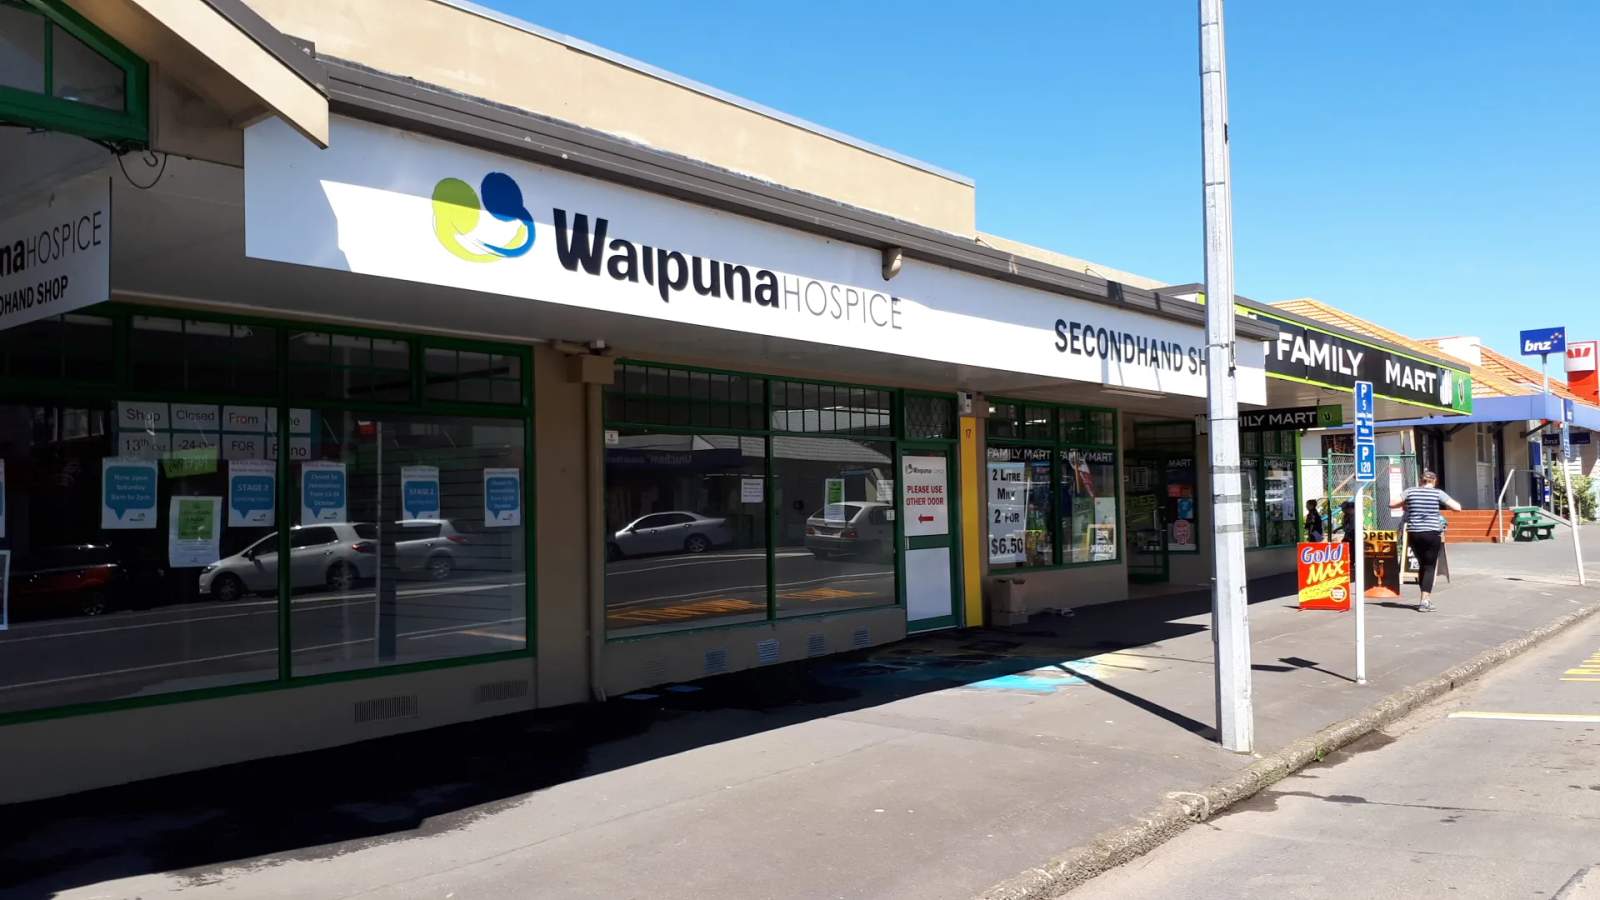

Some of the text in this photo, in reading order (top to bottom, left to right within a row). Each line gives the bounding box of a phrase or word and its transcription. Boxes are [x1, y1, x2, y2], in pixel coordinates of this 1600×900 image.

[37, 275, 68, 305] SHOP
[1054, 319, 1208, 376] SECONDHAND SH
[1524, 340, 1552, 352] bnz
[1276, 331, 1364, 377] FAMILY
[1385, 359, 1437, 394] MART
[1361, 384, 1368, 398] P
[1362, 400, 1367, 411] 5
[229, 412, 258, 425] From
[1239, 411, 1317, 428] ILY MART
[987, 448, 1052, 460] FAMILY MART
[1089, 452, 1113, 462] MART
[1362, 447, 1369, 461] P
[992, 468, 998, 481] 2
[906, 485, 943, 494] PLEASE USE
[906, 497, 944, 506] OTHER DOOR
[994, 509, 1001, 524] 2
[991, 538, 1023, 555] $6.50
[1301, 543, 1343, 564] Gold
